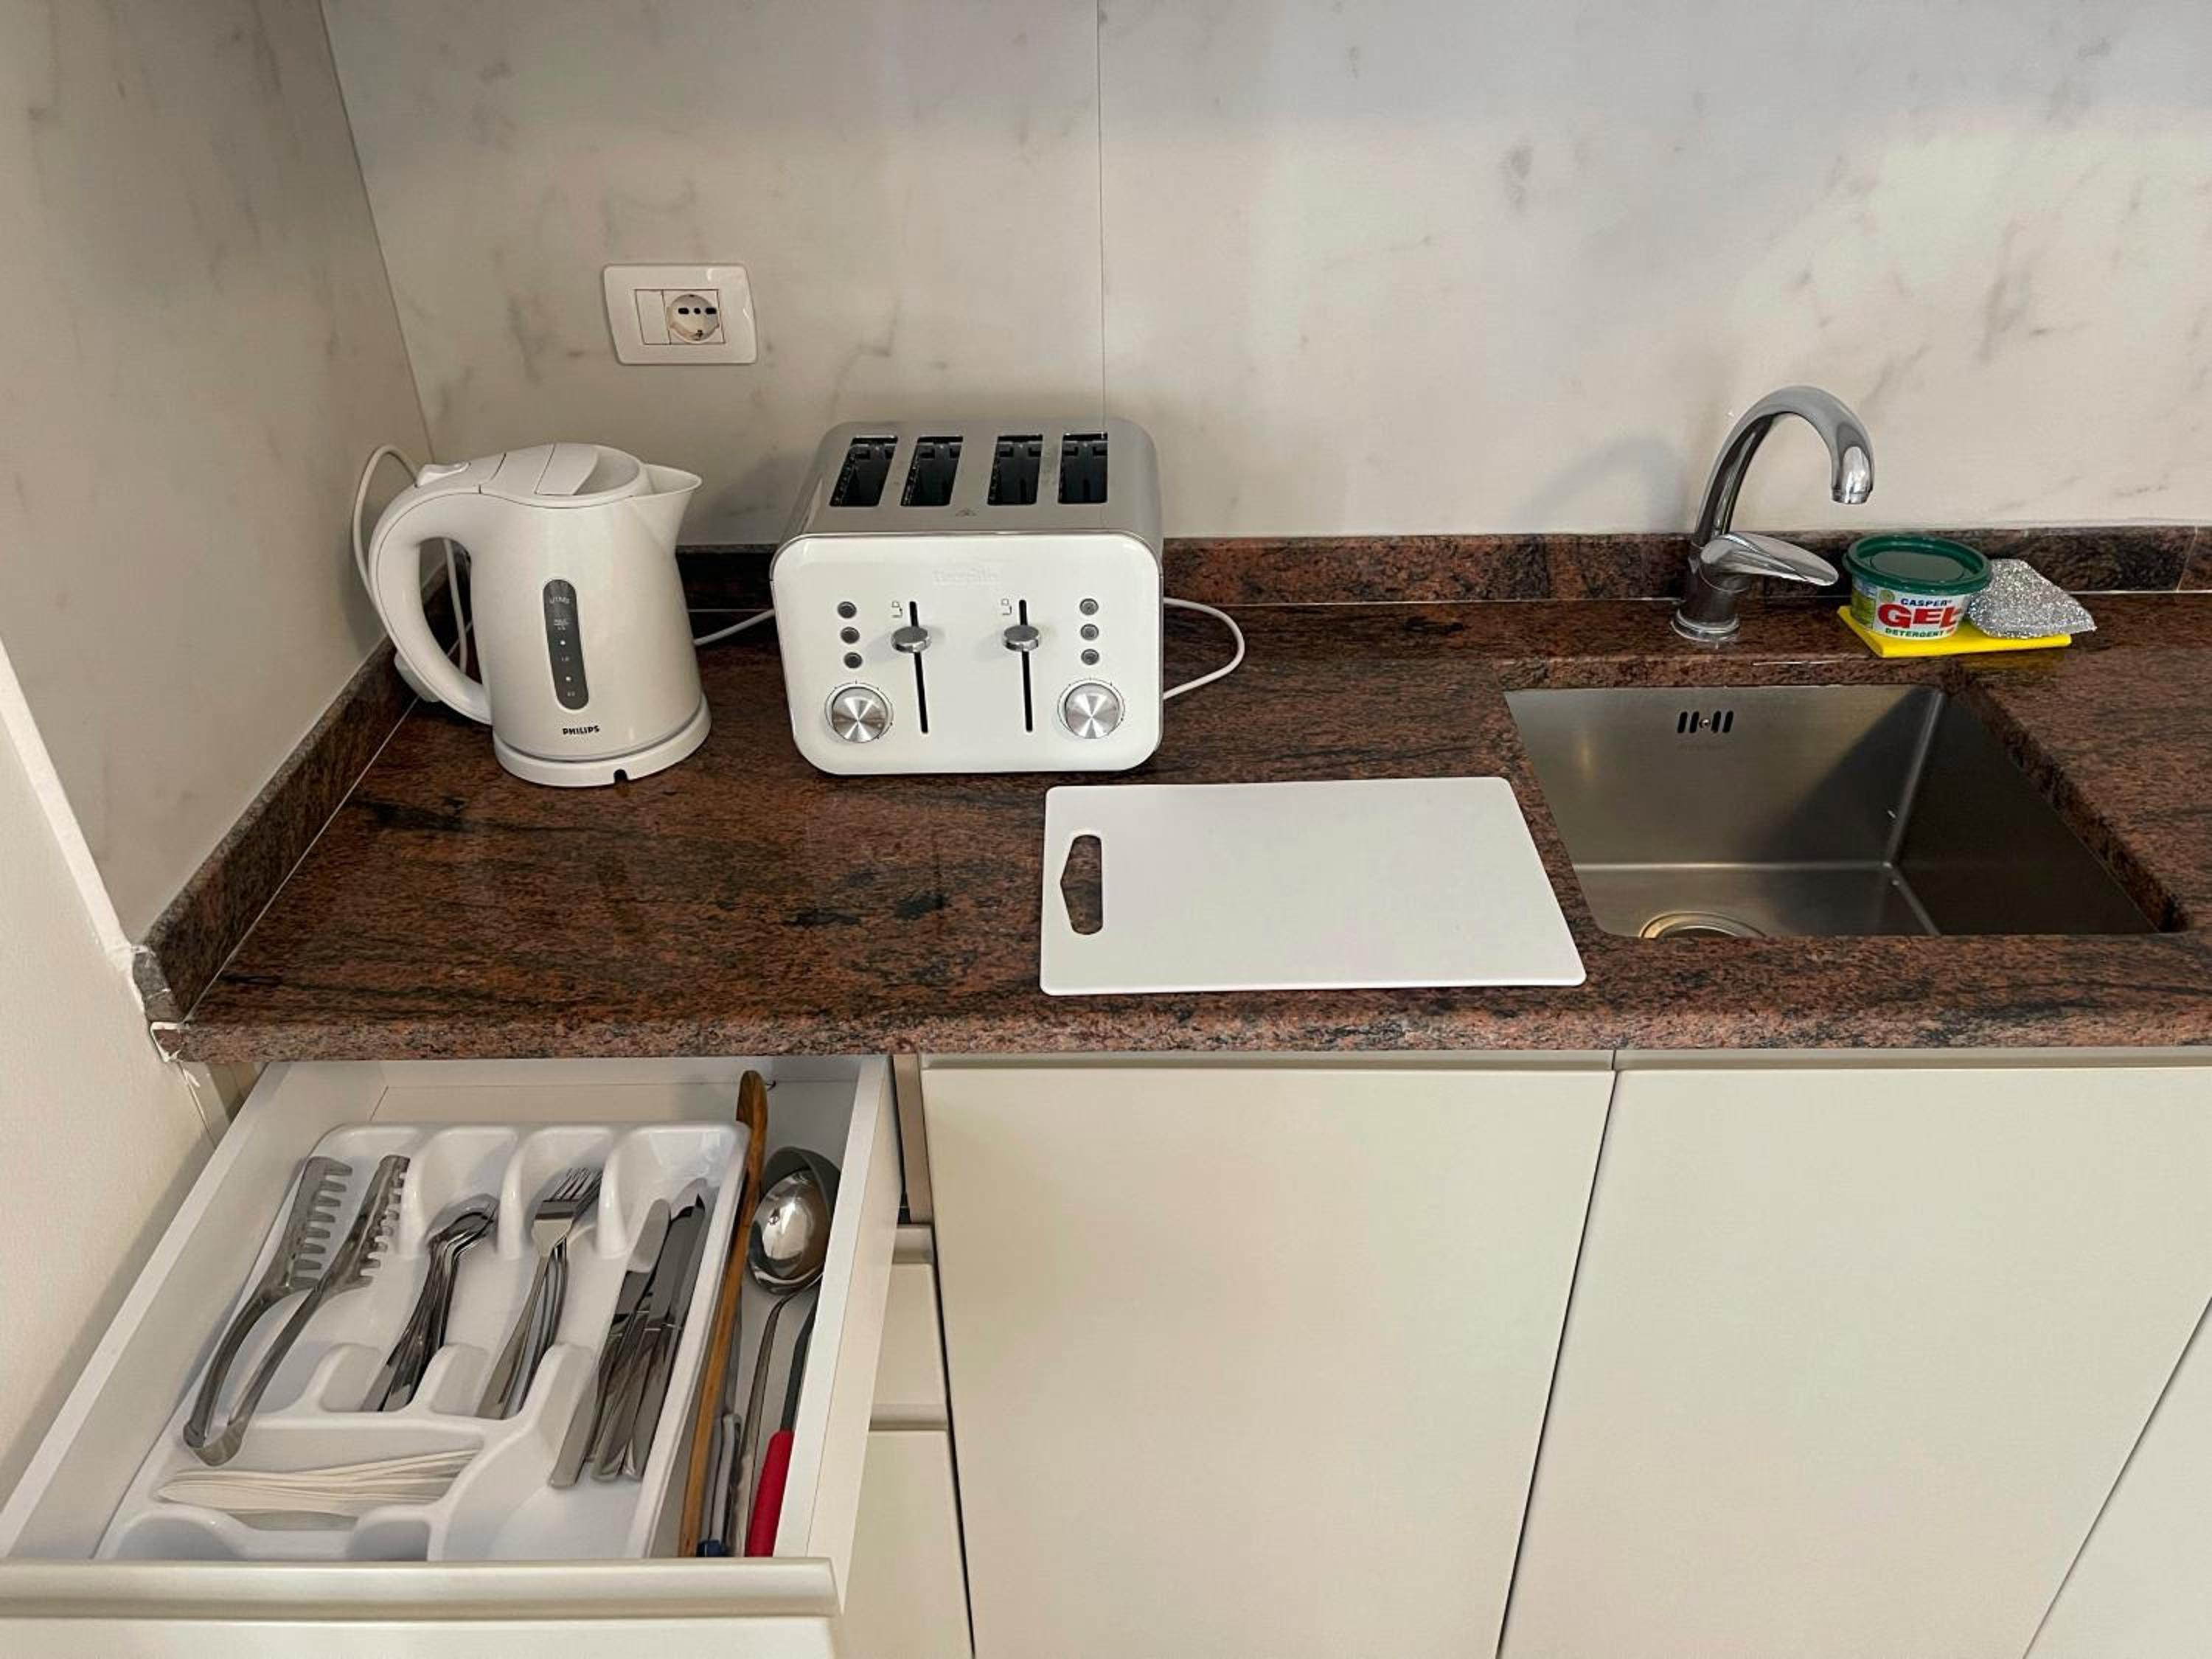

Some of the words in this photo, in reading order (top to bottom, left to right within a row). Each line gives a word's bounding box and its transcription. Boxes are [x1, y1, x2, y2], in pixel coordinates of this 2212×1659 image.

[1900, 598, 1947, 607] CASPER
[1877, 604, 1958, 628] GEL
[1885, 627, 1944, 638] DETERGENT
[562, 725, 599, 735] PHILIPS
